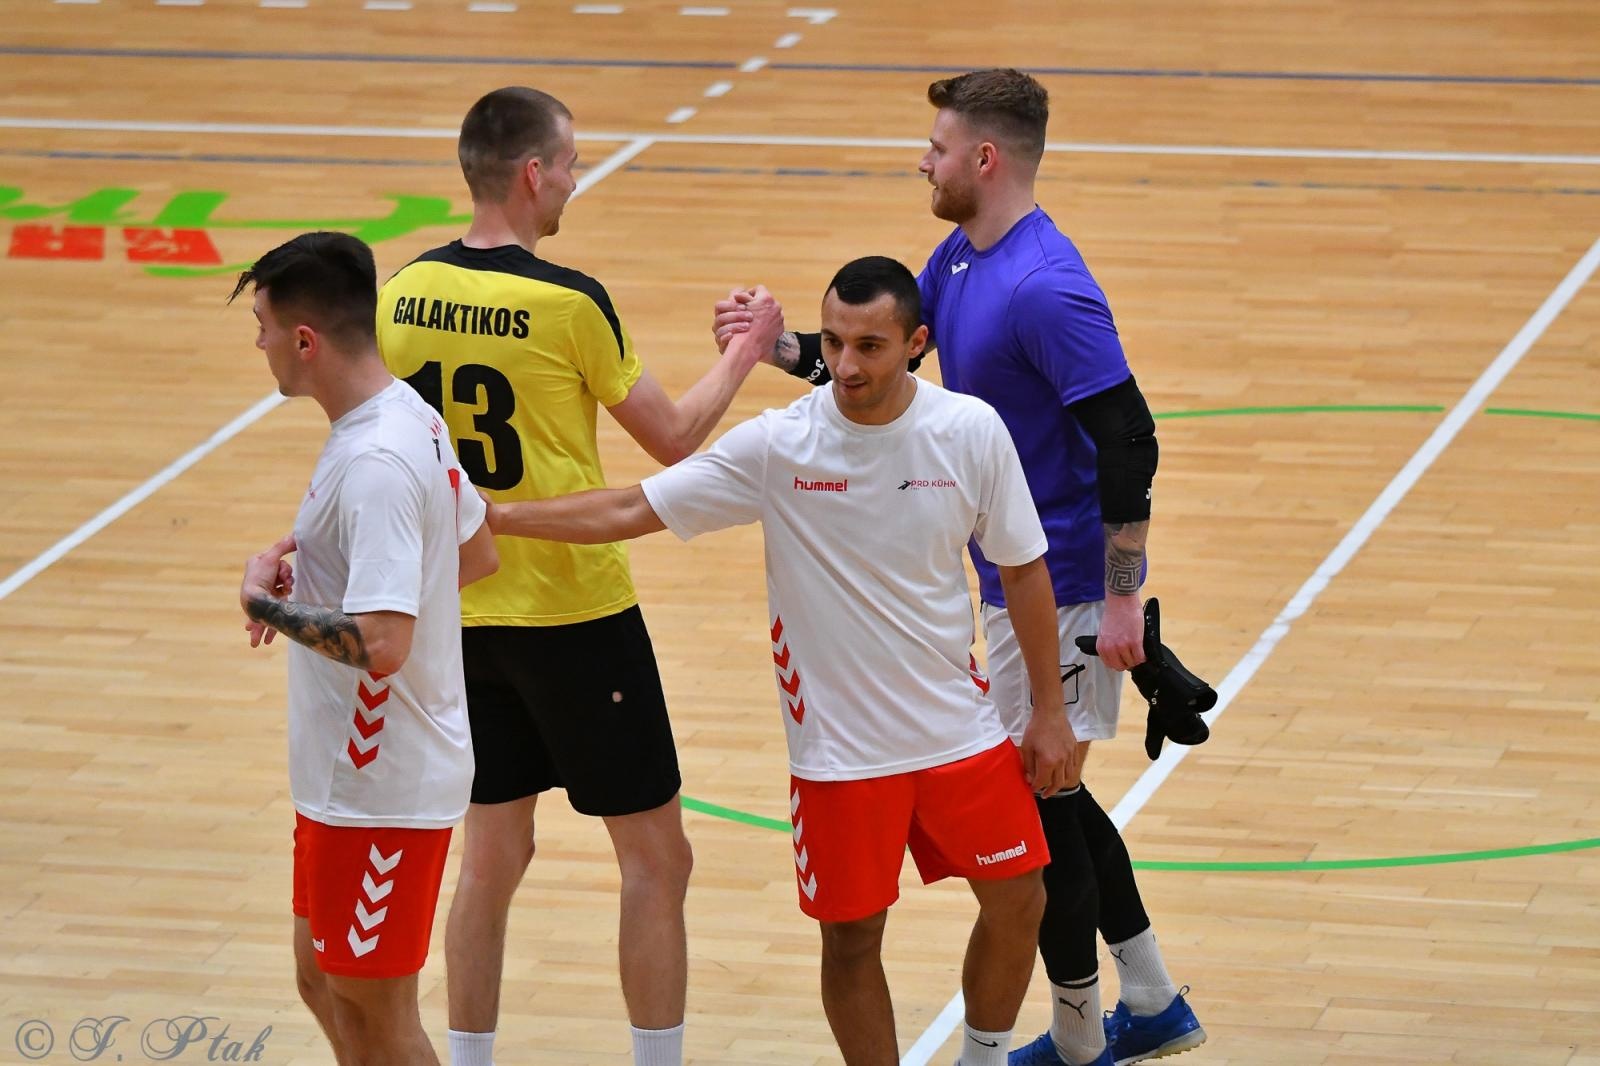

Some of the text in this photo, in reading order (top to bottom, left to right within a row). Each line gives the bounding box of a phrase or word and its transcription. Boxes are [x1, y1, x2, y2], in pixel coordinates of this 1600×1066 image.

[393, 296, 530, 339] GALAKTIKOS
[794, 477, 848, 492] hummel
[975, 840, 1028, 866] hummel
